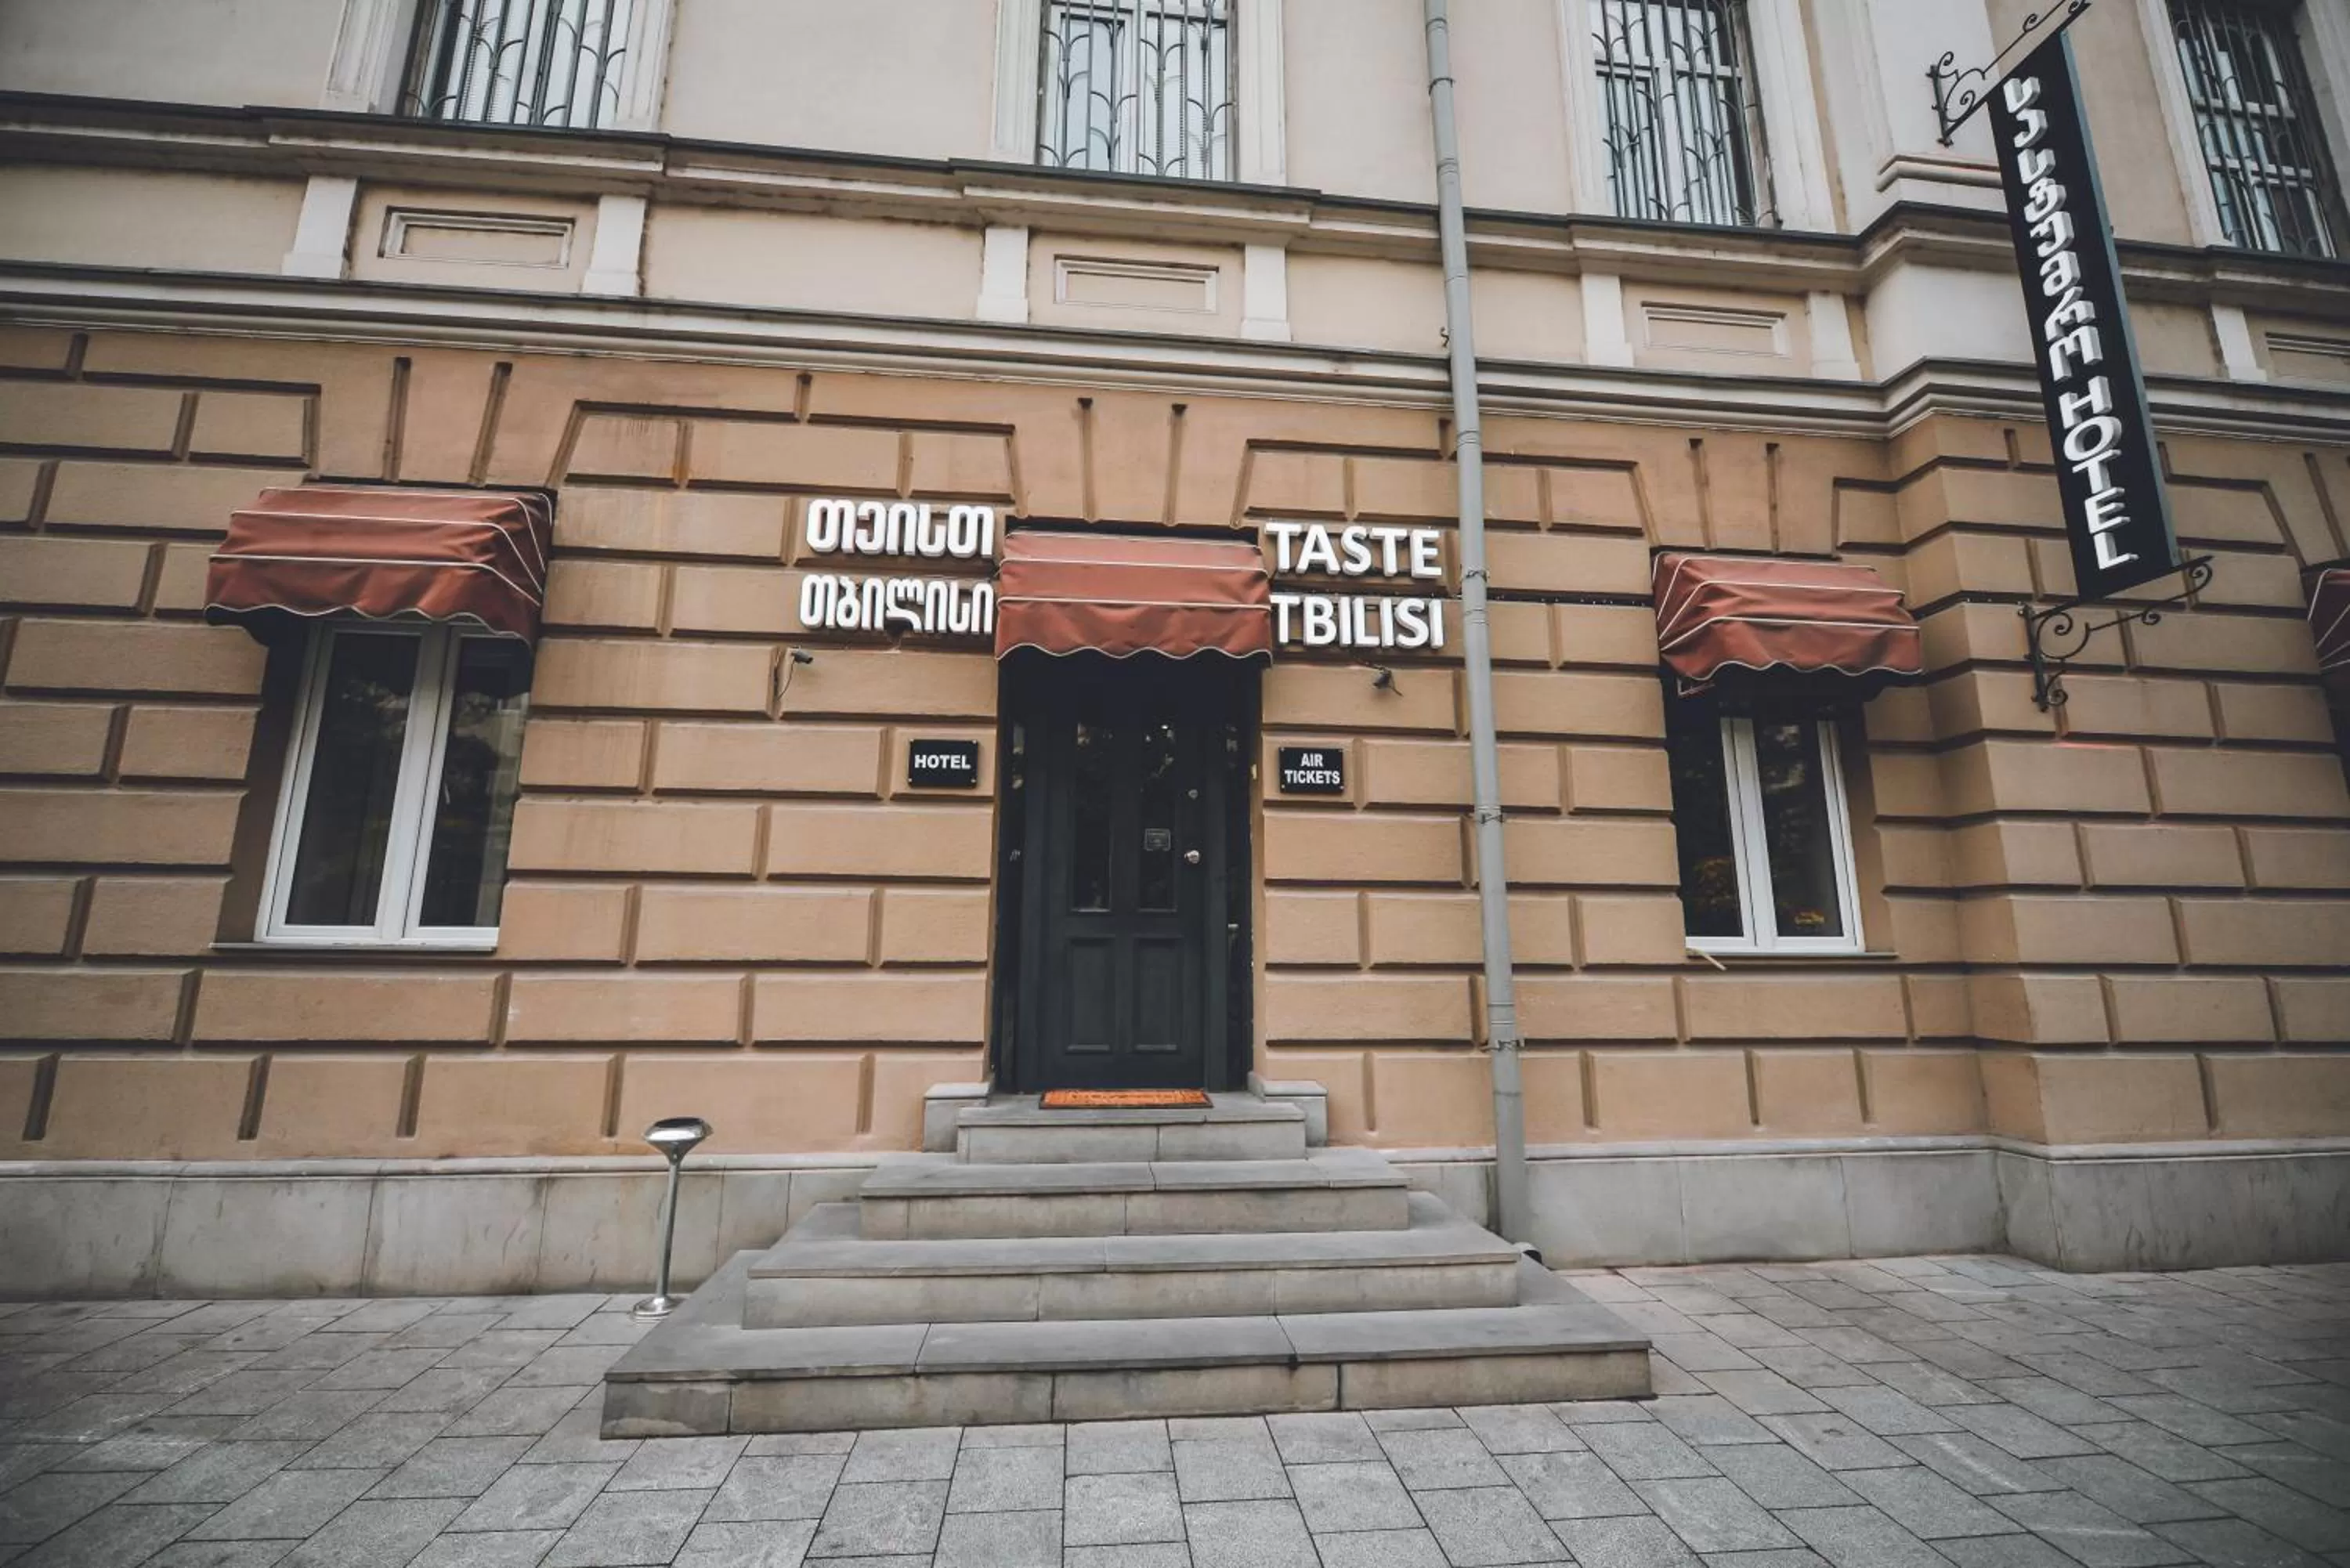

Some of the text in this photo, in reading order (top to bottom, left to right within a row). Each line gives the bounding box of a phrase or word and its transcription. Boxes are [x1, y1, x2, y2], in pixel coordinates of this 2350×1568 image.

[2003, 77, 2103, 382] სასტუმრო
[2059, 376, 2139, 570] HOTEL
[806, 499, 994, 558] თეისთ
[1264, 522, 1442, 578] TASTE
[800, 574, 994, 634] თბილისი
[1269, 594, 1444, 649] TBILISI
[914, 754, 971, 770] HOTEL
[1284, 770, 1340, 785] TICKETS
[1301, 753, 1323, 768] AIR
